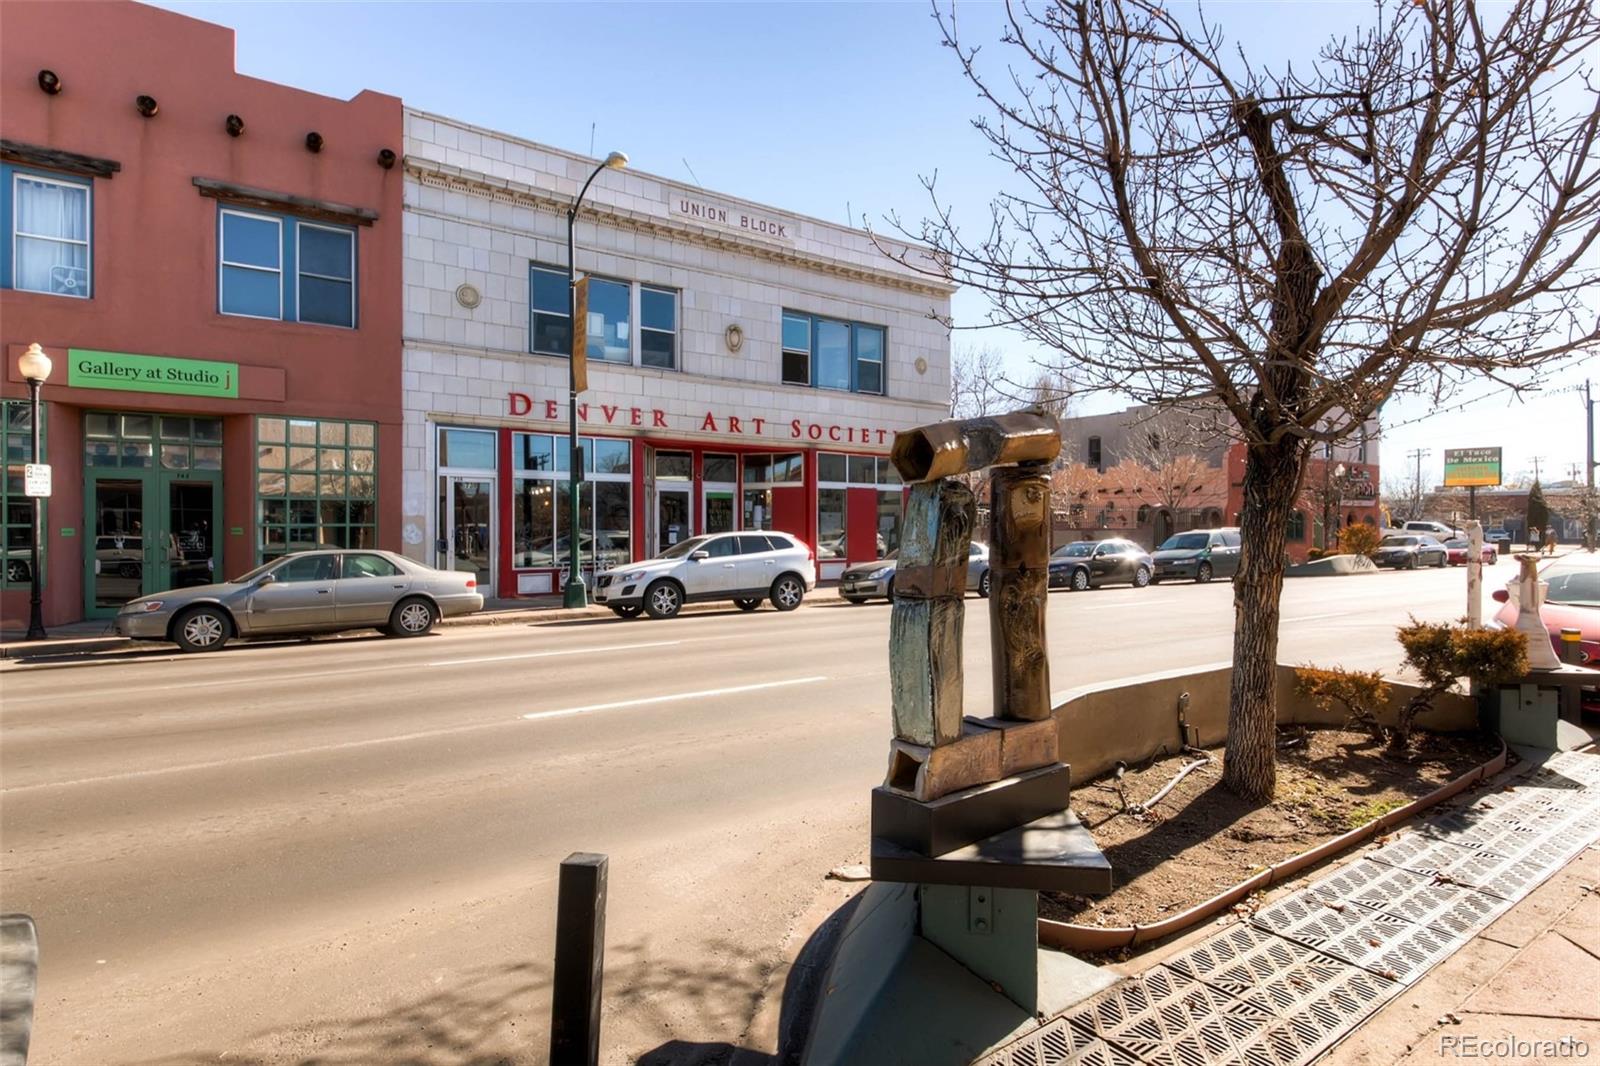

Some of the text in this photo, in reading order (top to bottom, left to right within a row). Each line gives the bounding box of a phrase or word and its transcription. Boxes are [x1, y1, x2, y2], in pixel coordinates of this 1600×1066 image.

[681, 200, 786, 237] UNION BLOCK
[78, 360, 231, 390] Gallery at Studio j
[701, 411, 765, 434] ART
[1463, 455, 1499, 463] Mexico
